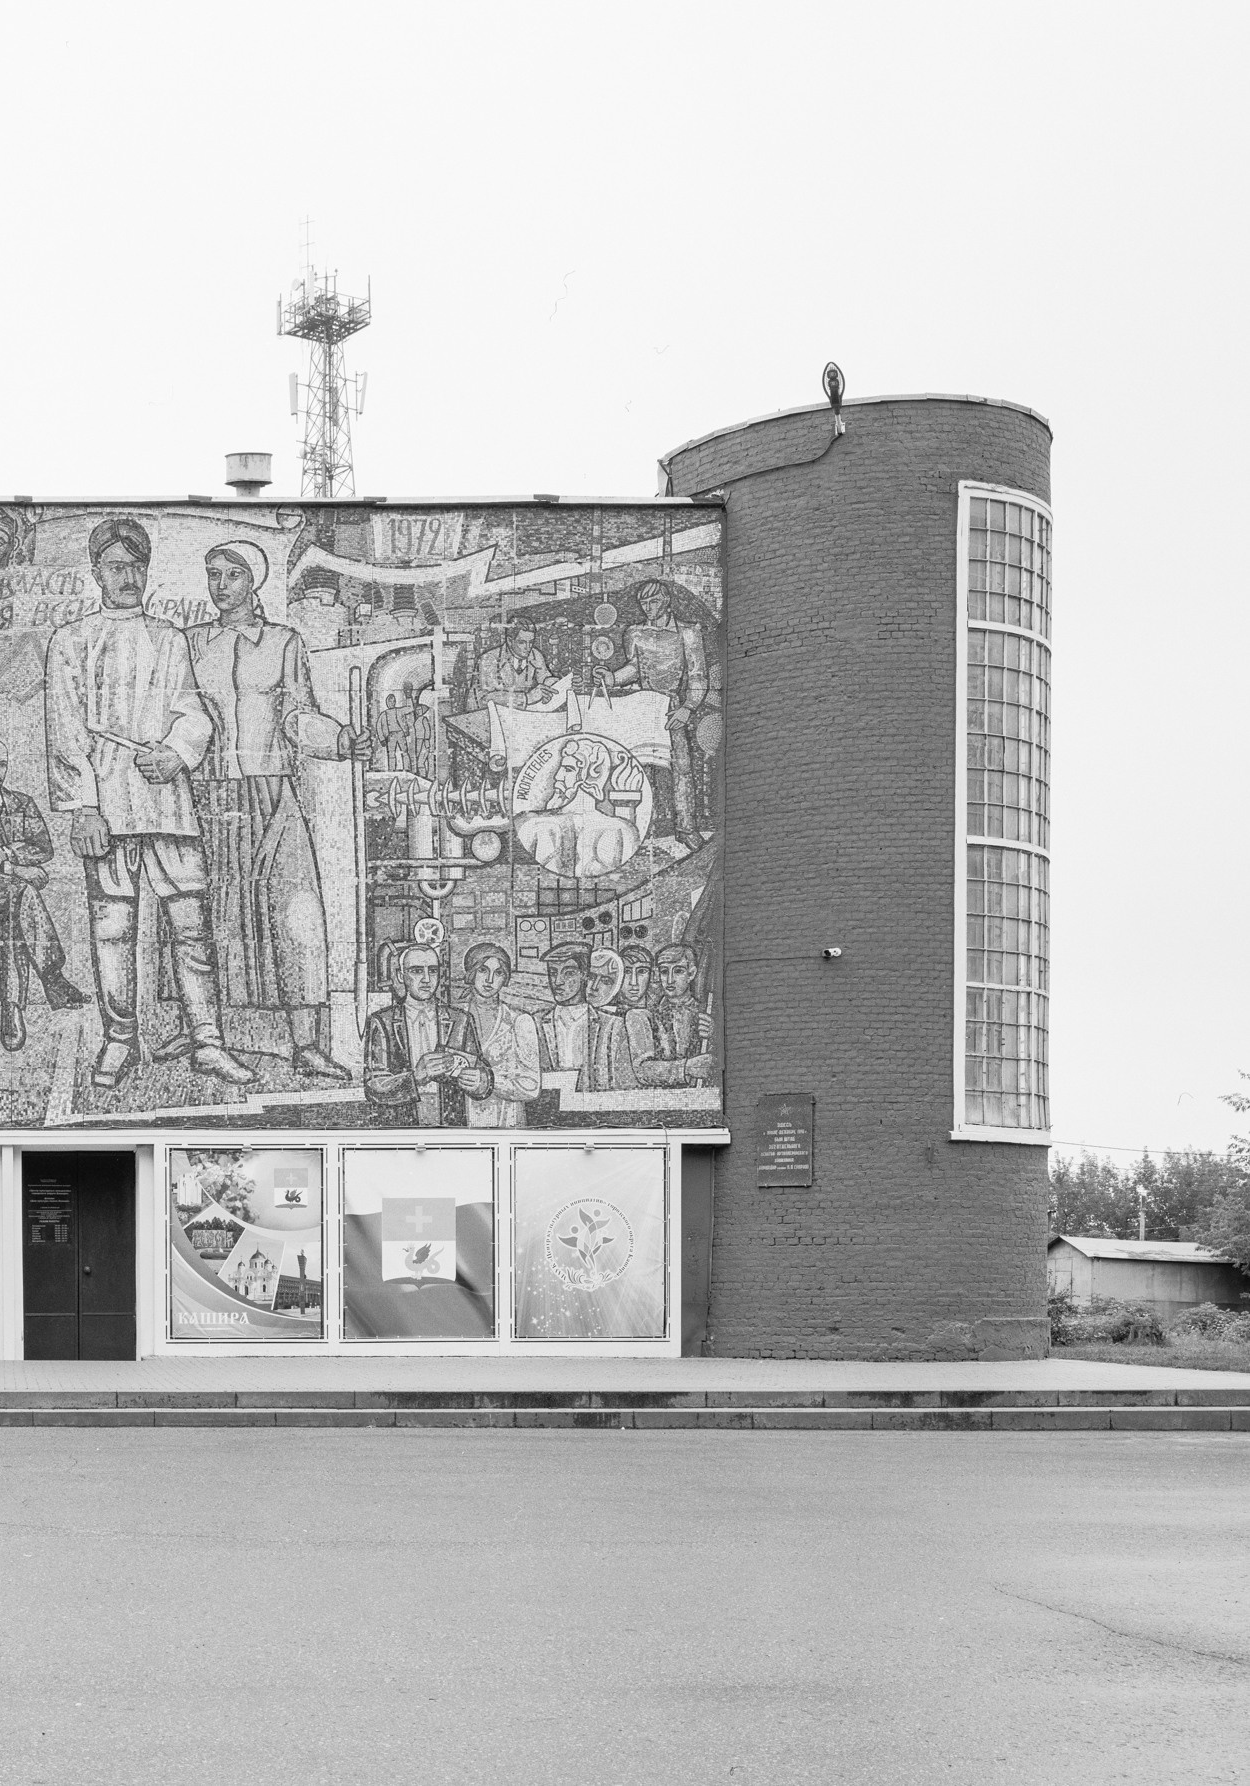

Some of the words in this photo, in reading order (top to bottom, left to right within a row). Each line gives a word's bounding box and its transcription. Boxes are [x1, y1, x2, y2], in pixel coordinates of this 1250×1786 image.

[387, 517, 443, 556] 1972
[0, 568, 85, 600] ВЛАСТЬ
[516, 749, 553, 801] PROMETEHES
[178, 1312, 250, 1325] КАШИРА
